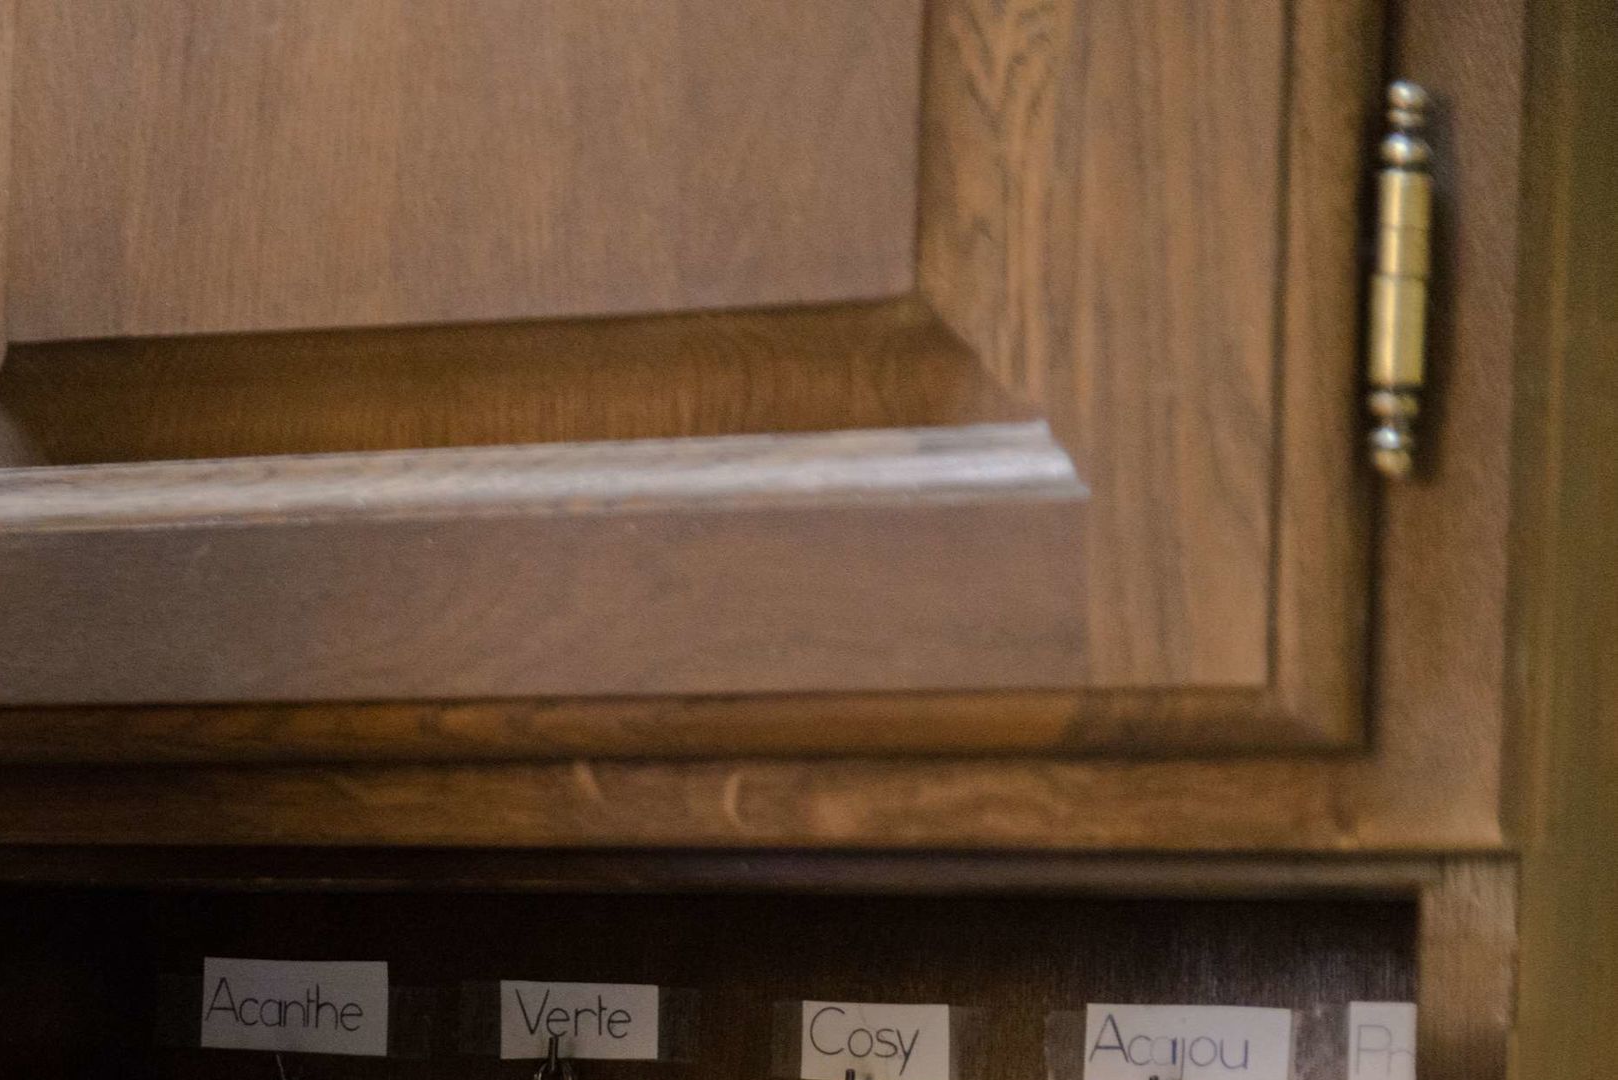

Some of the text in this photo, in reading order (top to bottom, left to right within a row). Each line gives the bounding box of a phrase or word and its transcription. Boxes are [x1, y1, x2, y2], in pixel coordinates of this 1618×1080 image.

[204, 976, 364, 1032] Acanthe
[514, 988, 634, 1039] Verte
[808, 1006, 920, 1076] Cosy
